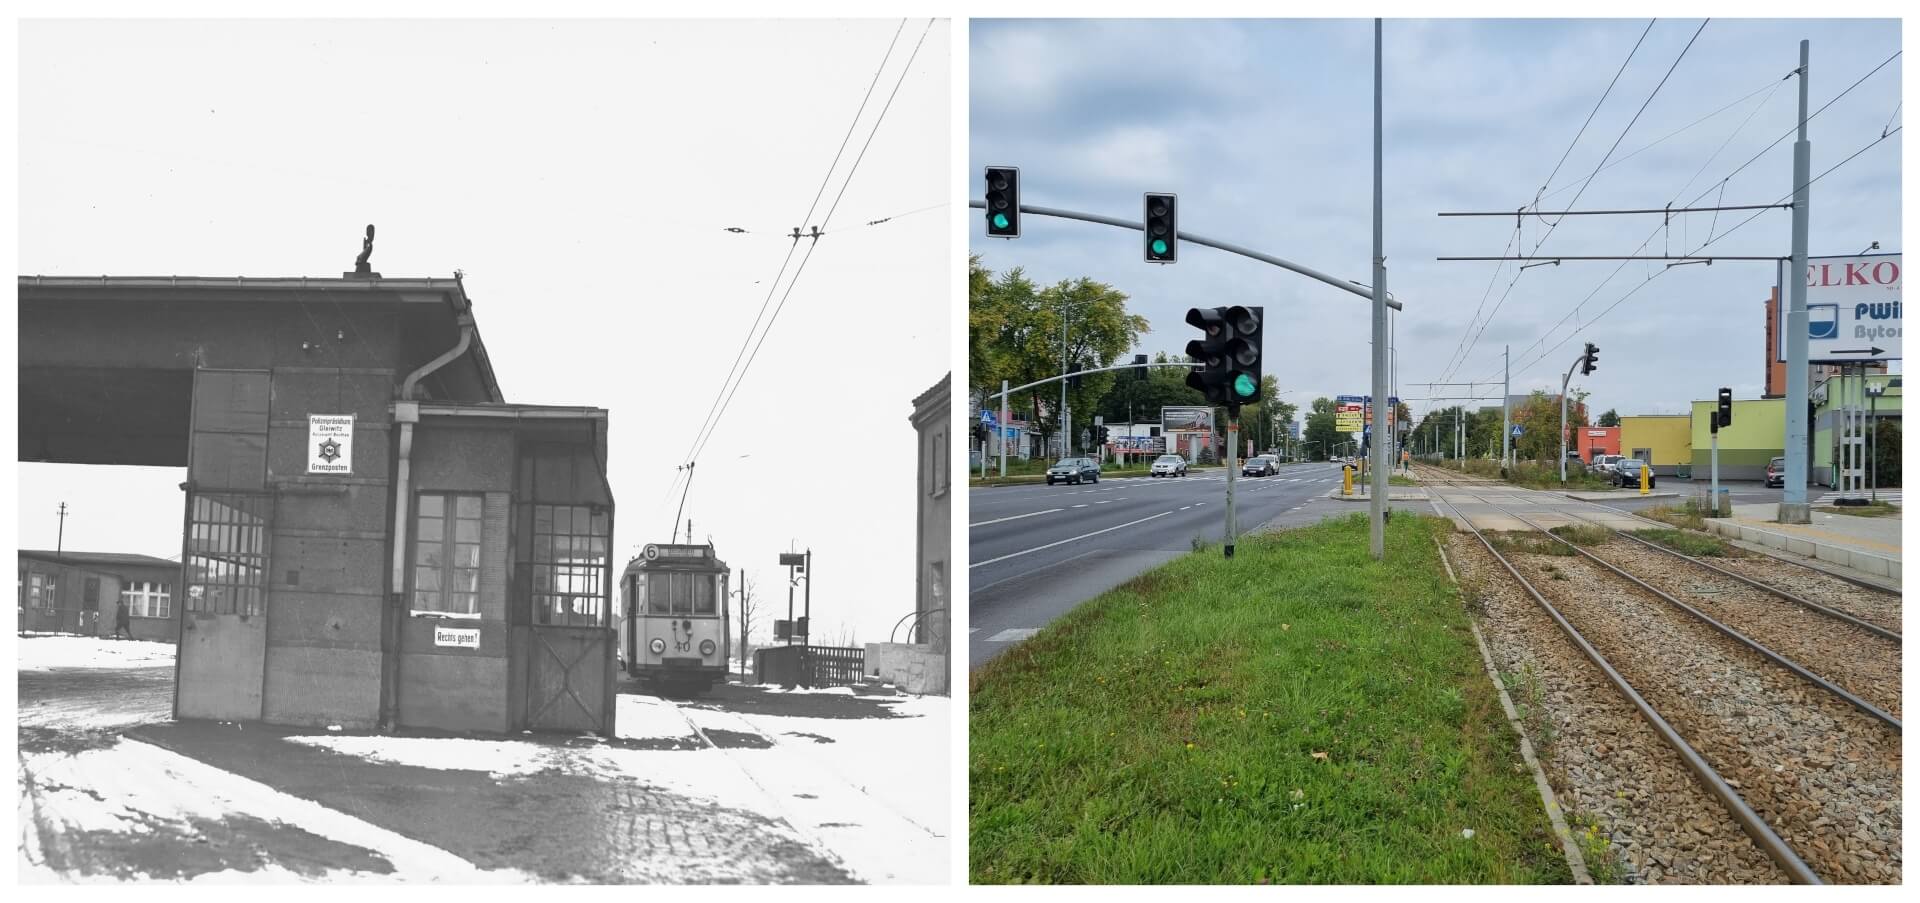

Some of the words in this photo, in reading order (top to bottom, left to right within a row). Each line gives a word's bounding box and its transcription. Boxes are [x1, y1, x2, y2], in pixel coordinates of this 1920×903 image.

[311, 463, 348, 472] Grenzposten
[647, 546, 656, 558] 6
[437, 631, 456, 642] Rechts
[457, 632, 478, 645] gehen!
[675, 641, 691, 652] 40
